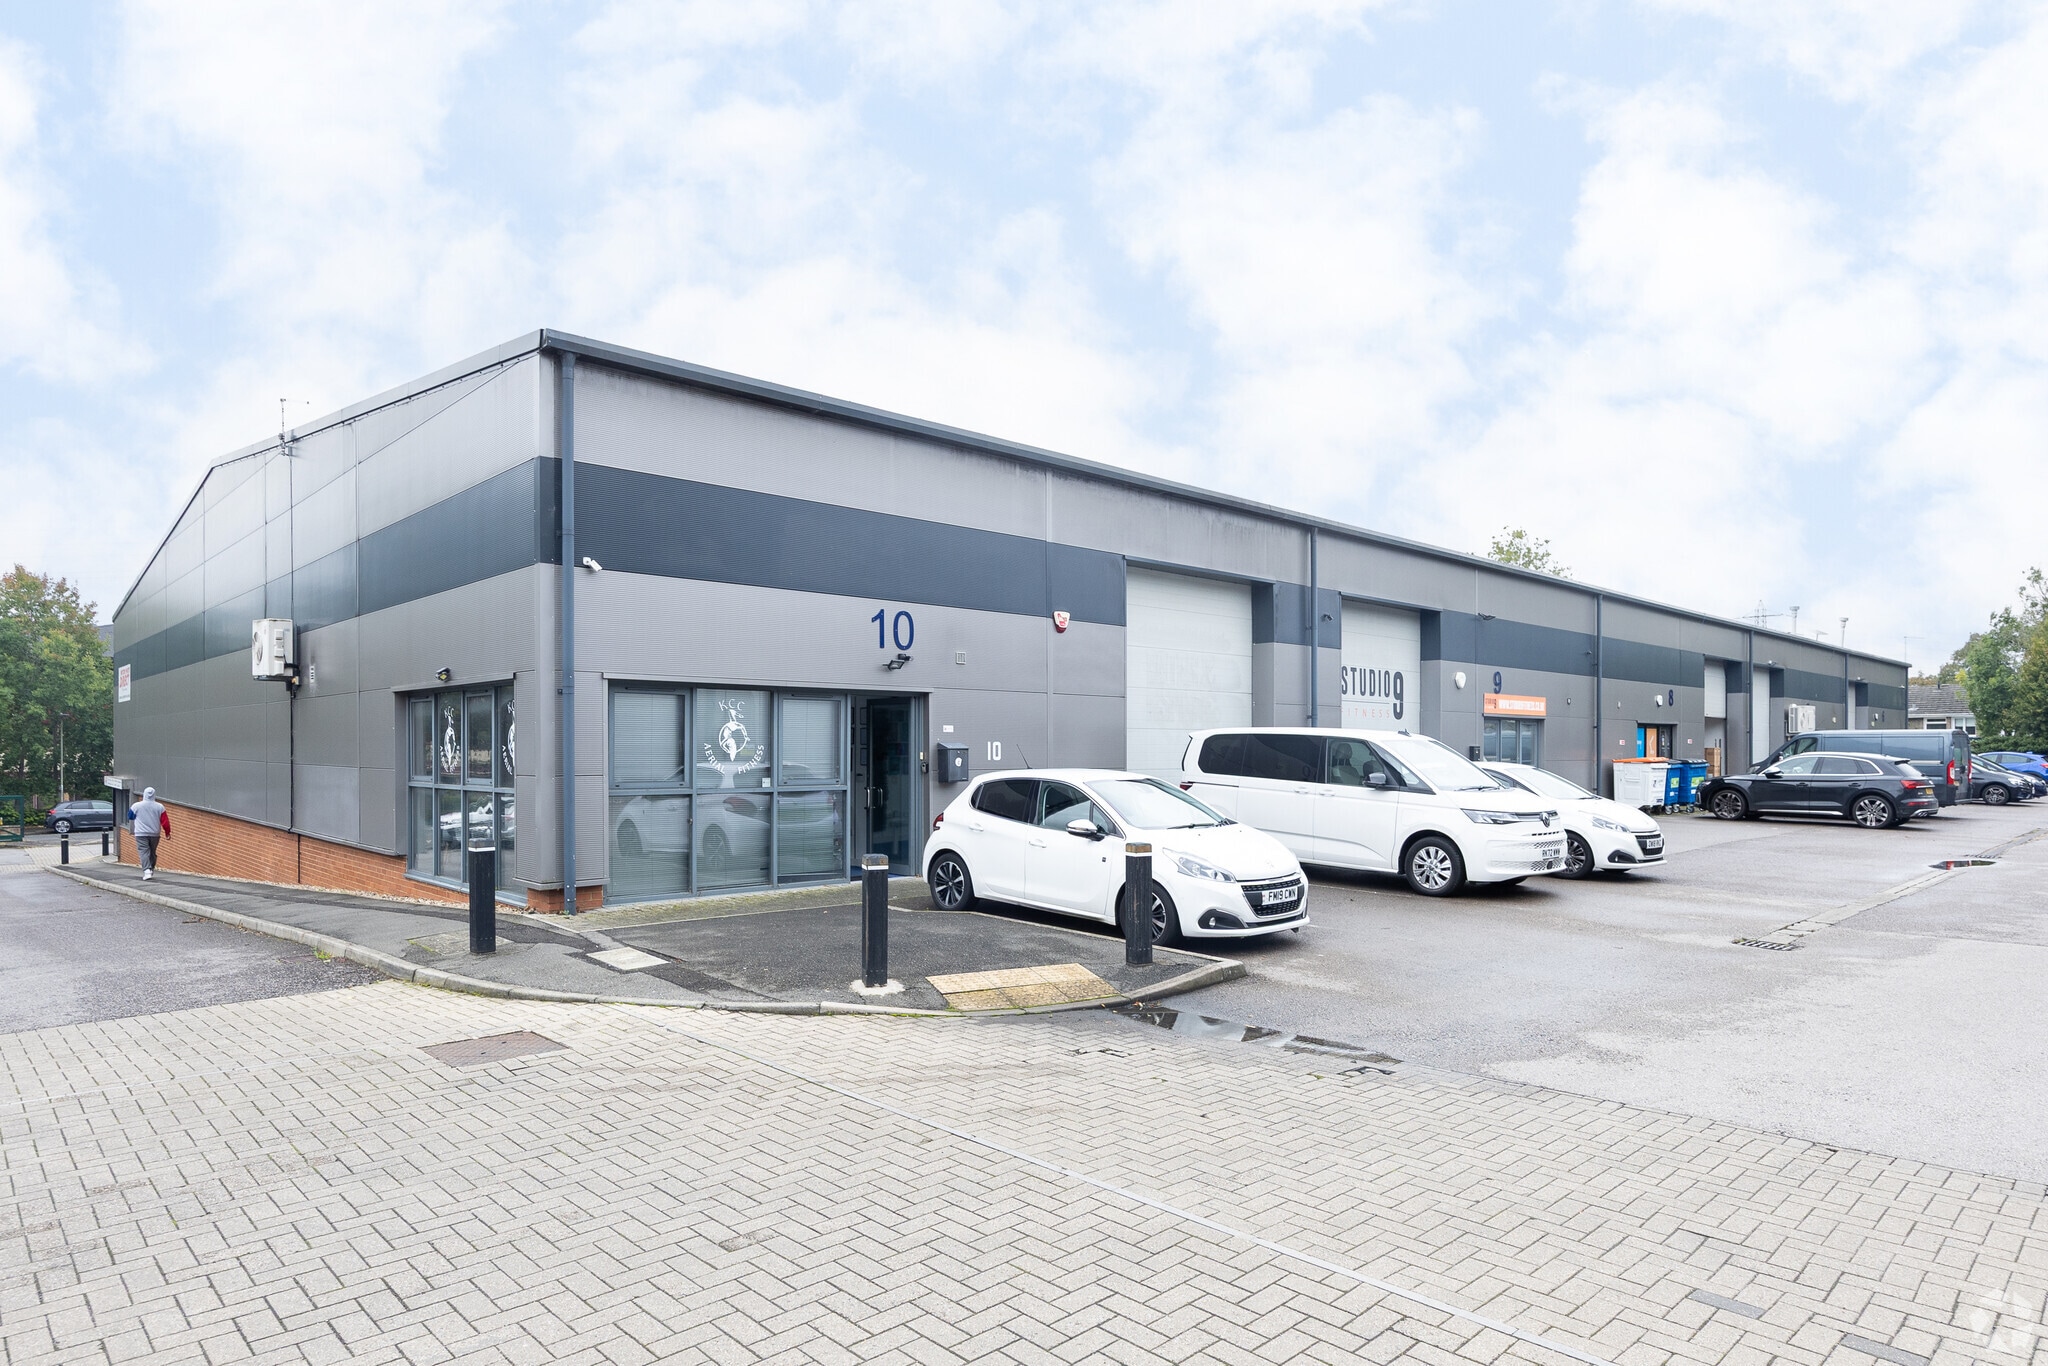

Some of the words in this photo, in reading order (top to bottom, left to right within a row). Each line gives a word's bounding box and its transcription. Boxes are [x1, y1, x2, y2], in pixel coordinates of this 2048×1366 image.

[871, 608, 914, 650] 10
[1493, 671, 1502, 694] 9
[1341, 665, 1390, 698] STUDIO
[1393, 671, 1403, 720] 9
[1668, 690, 1674, 707] 8
[507, 699, 515, 714] KC
[718, 699, 746, 711] KCC
[1341, 707, 1391, 718] ITNESS
[704, 743, 726, 774] AERIAL
[738, 745, 765, 775] FITNESS
[987, 741, 1001, 761] 10
[1268, 890, 1284, 902] FM19
